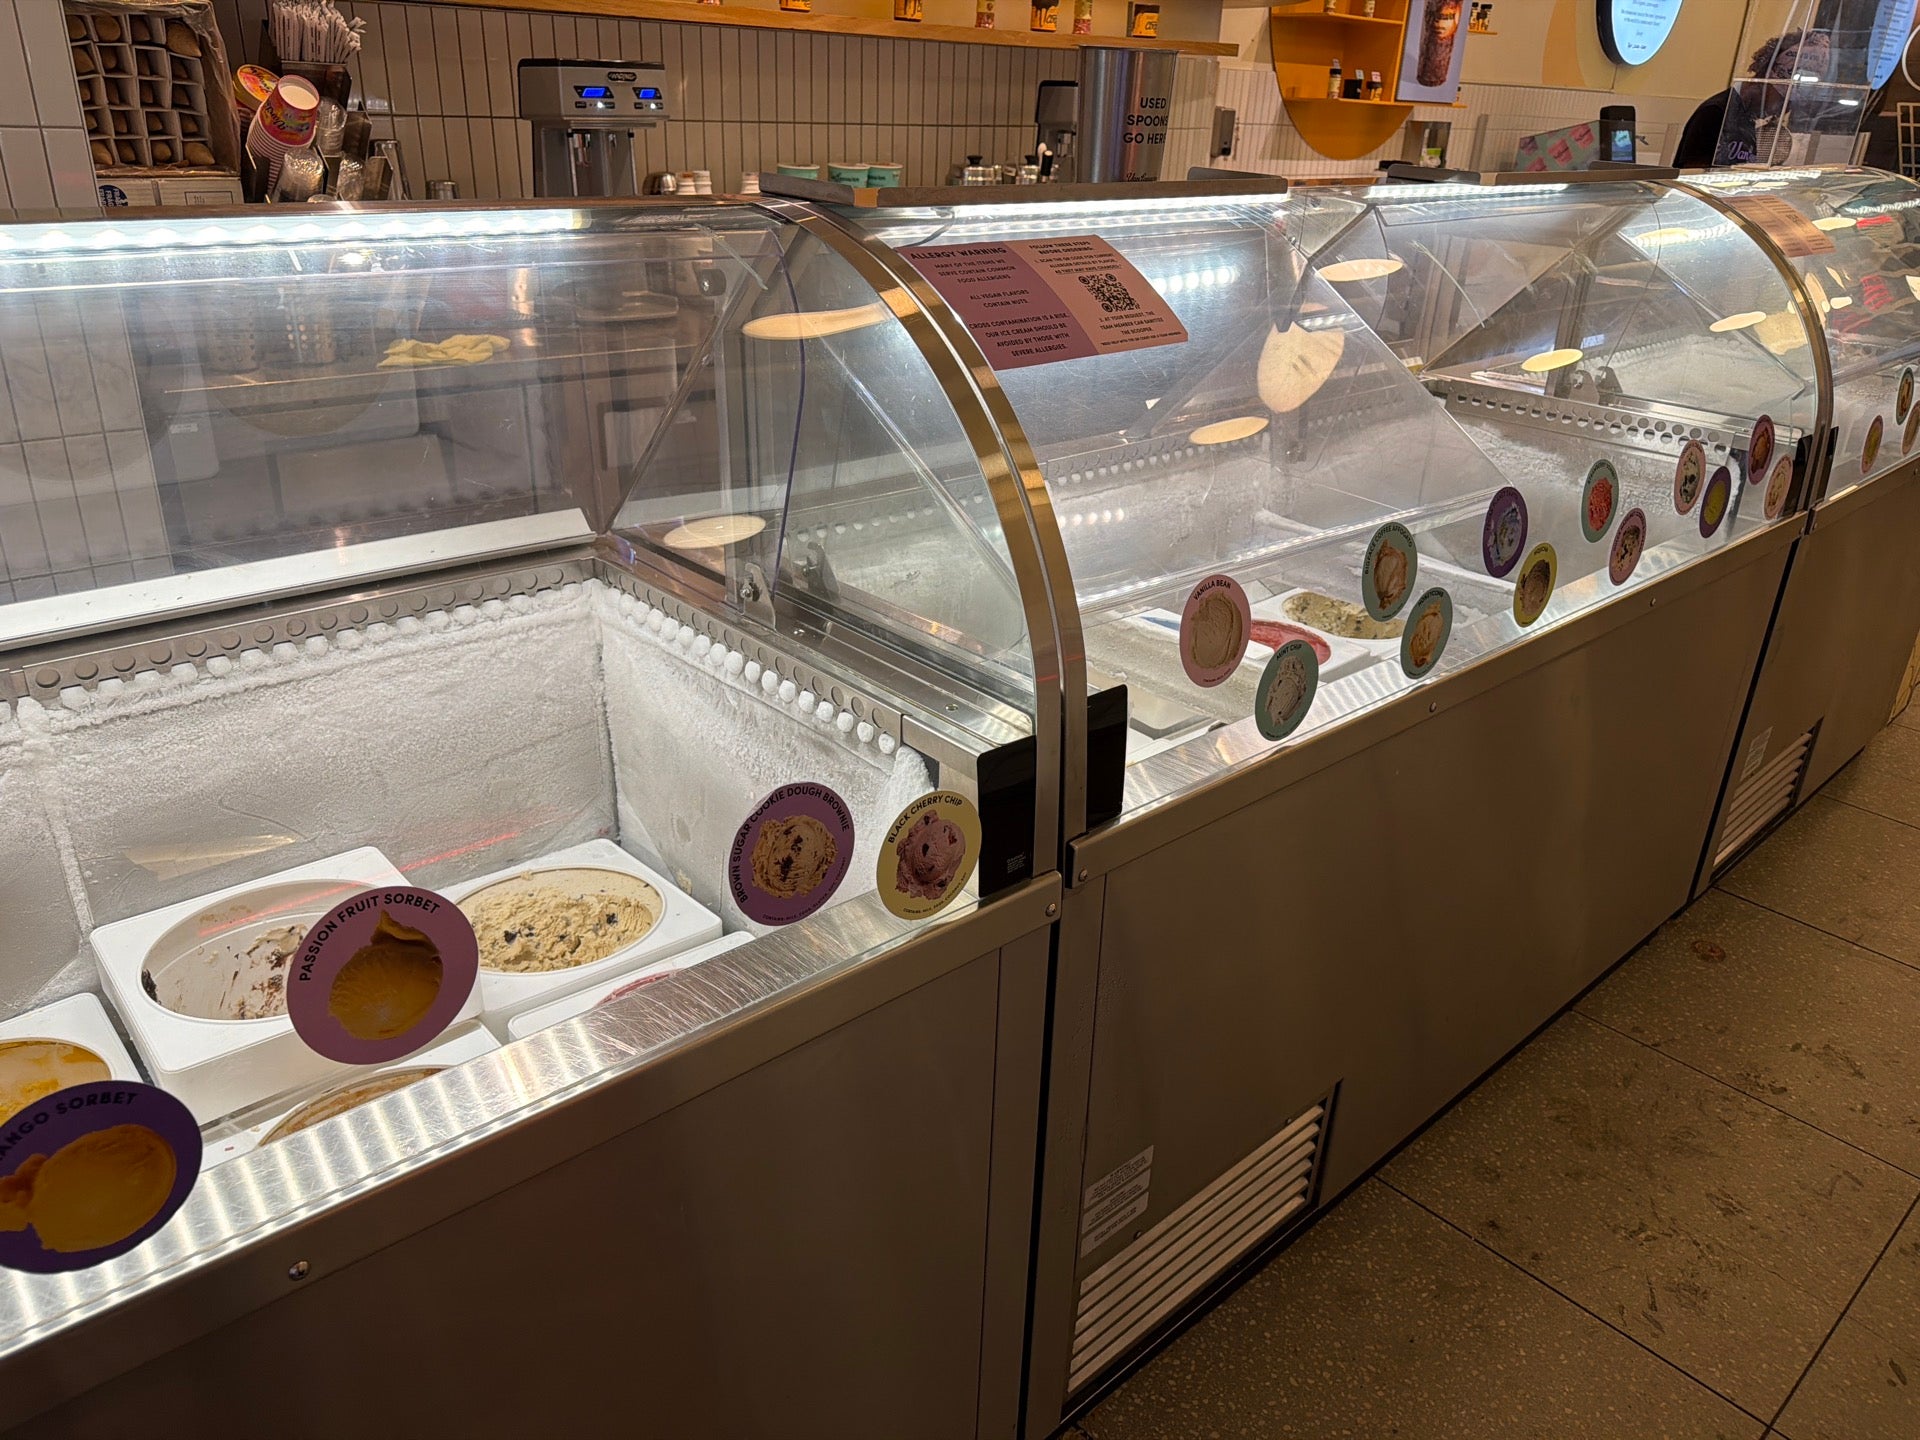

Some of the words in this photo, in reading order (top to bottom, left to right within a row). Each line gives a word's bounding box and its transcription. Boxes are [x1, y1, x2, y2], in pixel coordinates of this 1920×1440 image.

[1140, 97, 1166, 109] USED
[1123, 132, 1144, 144] GO
[910, 251, 956, 260] ALLERGY
[957, 247, 1007, 256] WARNING
[987, 265, 1017, 273] COMMON
[1002, 289, 1030, 297] FLAVORS
[991, 316, 1042, 327] CONTAMINATION
[1034, 324, 1058, 332] SHOULD
[1033, 335, 1053, 343] THOSE
[1011, 349, 1035, 357] SEVERE
[1375, 525, 1391, 542] COFFEE
[1392, 524, 1413, 547] AFFOGATO
[1193, 580, 1215, 600] VANILLA
[1216, 579, 1231, 589] BEAN
[1277, 646, 1289, 661] MINT
[1290, 643, 1303, 651] CHIP
[786, 786, 822, 798] DOUGH
[750, 790, 785, 823] COOKIE
[822, 792, 850, 832] BROWNIE
[888, 814, 911, 843] BLACK
[910, 794, 944, 815] CHERRY
[944, 795, 963, 807] CHIP
[733, 823, 752, 862] SUGAR
[732, 865, 748, 903] BROWN
[299, 920, 338, 981] PASSION
[337, 895, 380, 923] FRUIT
[384, 893, 440, 914] SORBET
[55, 1091, 139, 1115] SORBET
